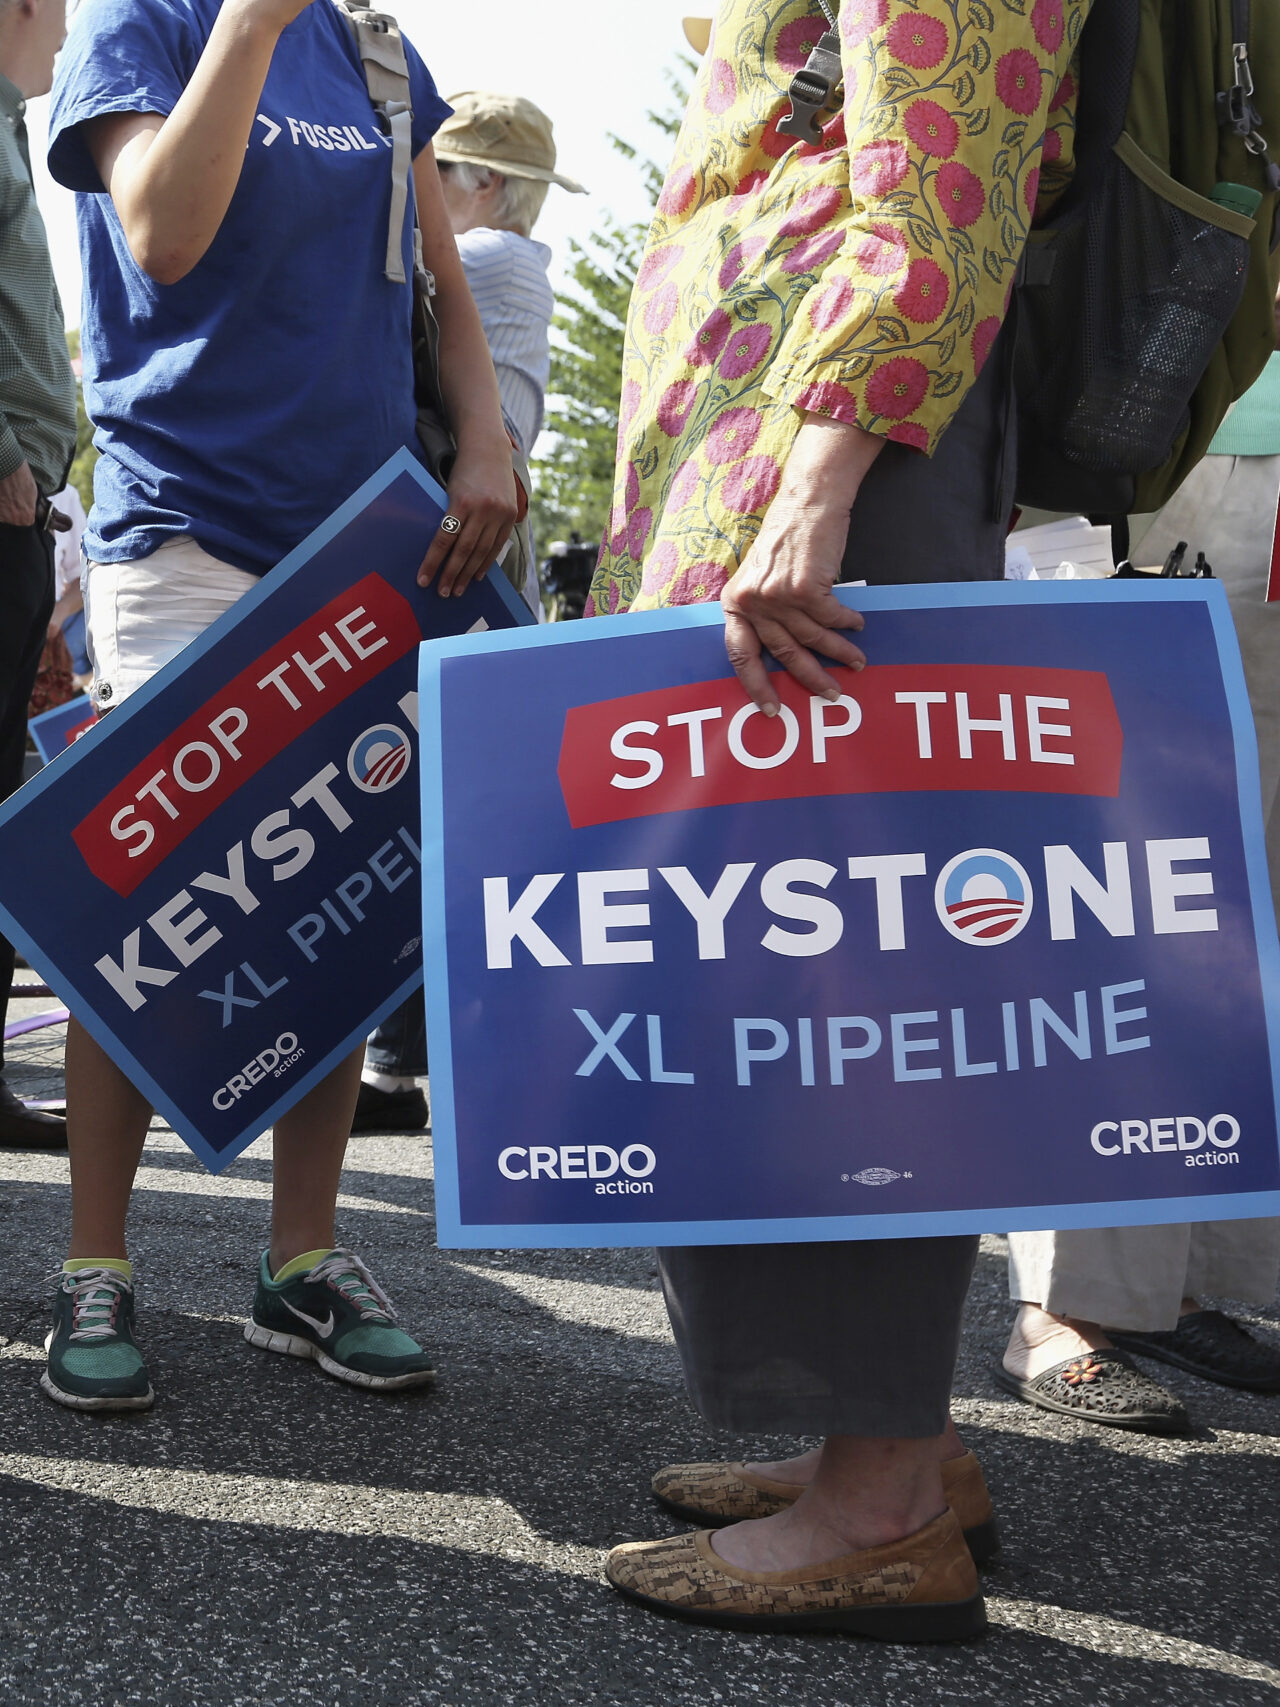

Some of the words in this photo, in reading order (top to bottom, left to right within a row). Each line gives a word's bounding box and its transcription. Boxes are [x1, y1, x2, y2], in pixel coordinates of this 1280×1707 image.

[285, 116, 377, 152] FOSSIL
[110, 706, 249, 858] STOP
[257, 605, 389, 711] THE
[609, 694, 862, 790] STOP
[895, 691, 1076, 766] THE
[94, 691, 420, 1012] KEYSTO
[197, 957, 290, 1029] XL
[286, 826, 423, 965] PIPE
[482, 836, 1220, 970] KEYSTONE
[211, 1031, 299, 1112] CREDO
[272, 1046, 306, 1080] action
[572, 1008, 695, 1086] XL
[733, 979, 1152, 1087] PIPELINE
[498, 1143, 657, 1181] CREDO
[1090, 1113, 1241, 1157] CREDO
[1184, 1149, 1240, 1168] action
[594, 1175, 654, 1195] action
